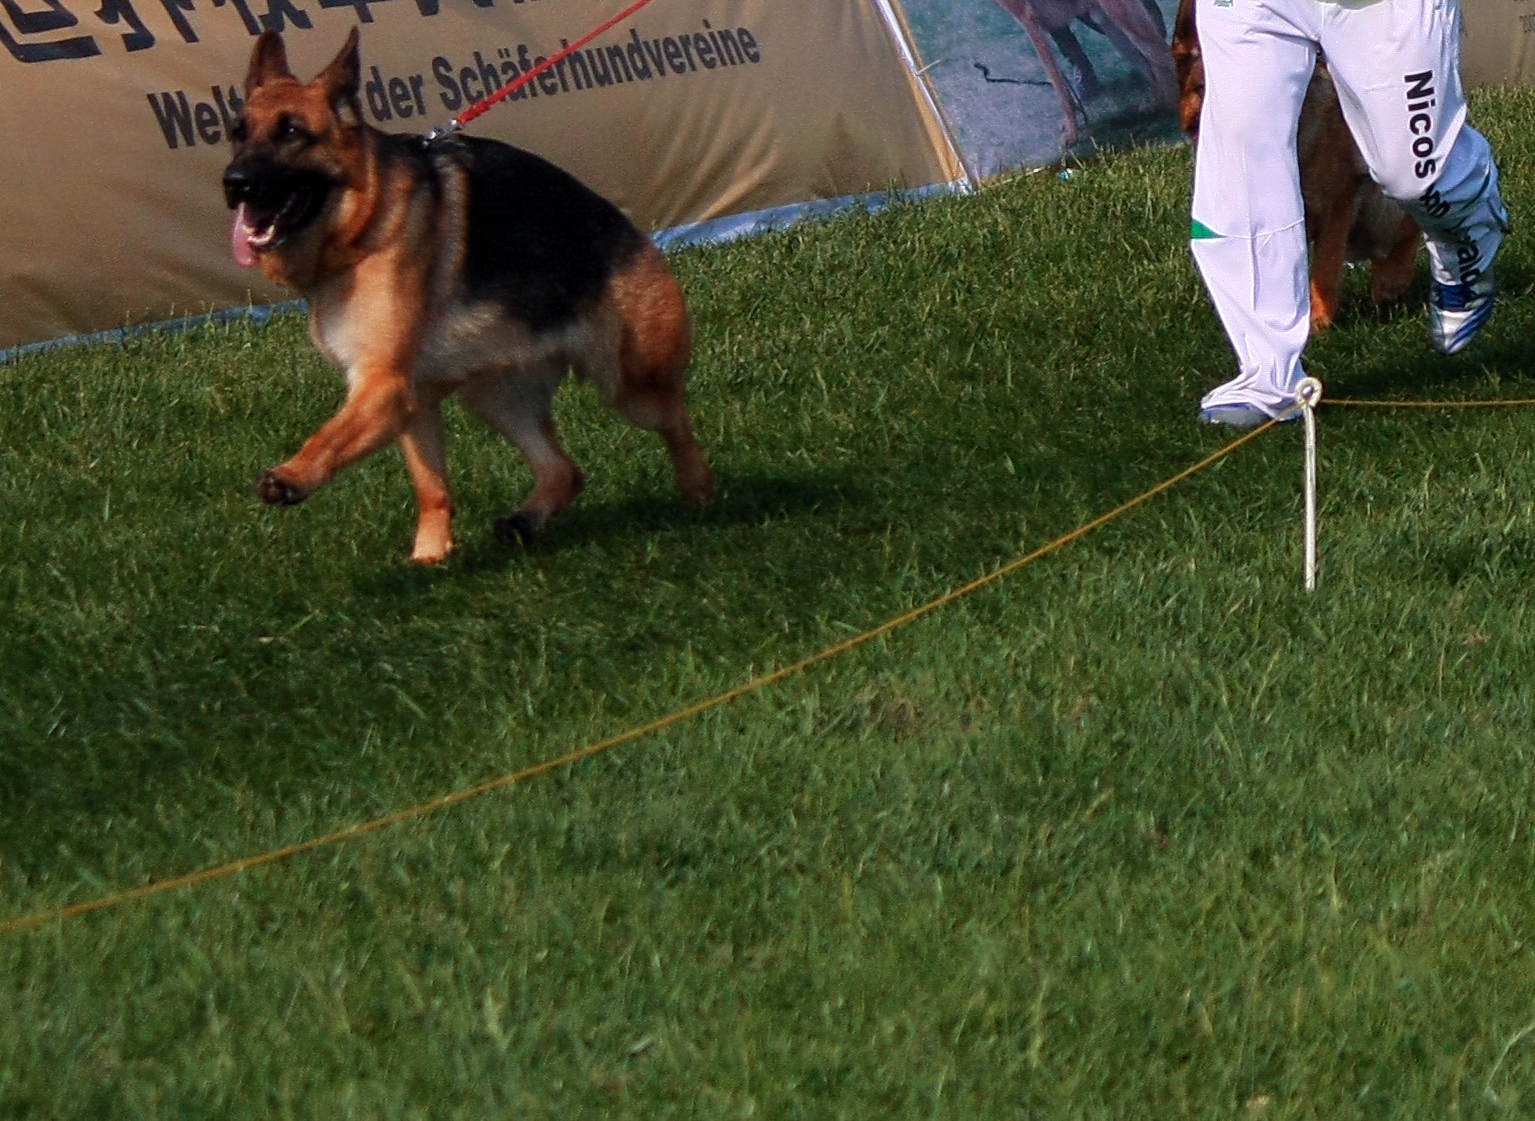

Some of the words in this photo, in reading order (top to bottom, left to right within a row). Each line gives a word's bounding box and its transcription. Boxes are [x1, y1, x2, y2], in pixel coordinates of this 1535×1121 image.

[147, 84, 246, 150] Welt
[365, 66, 425, 122] der
[431, 19, 761, 112] Schäferhundvereine
[1404, 70, 1437, 179] Nicos
